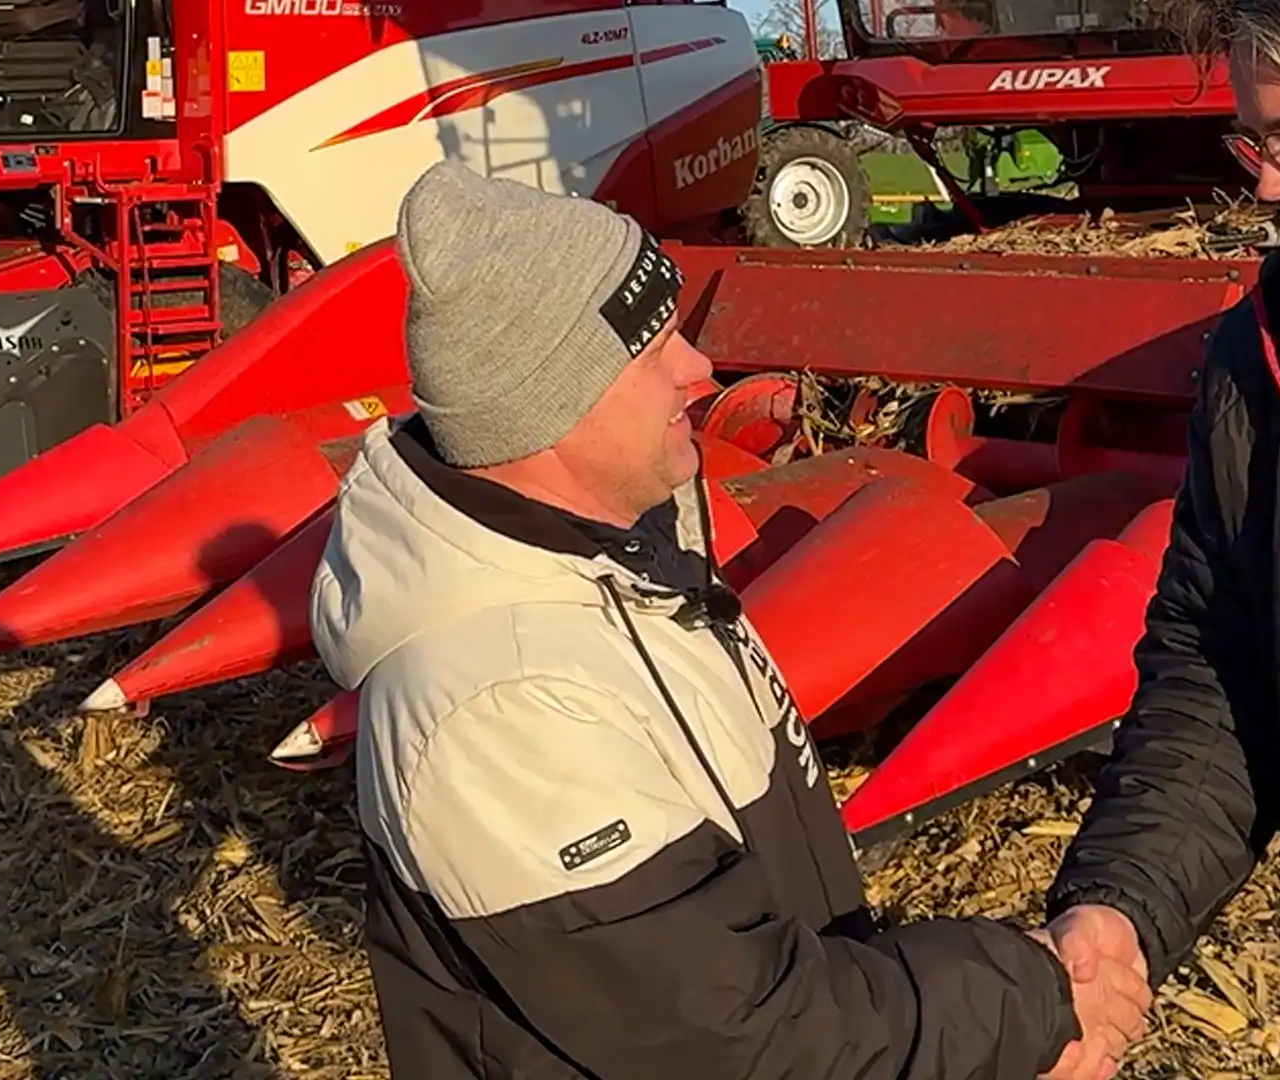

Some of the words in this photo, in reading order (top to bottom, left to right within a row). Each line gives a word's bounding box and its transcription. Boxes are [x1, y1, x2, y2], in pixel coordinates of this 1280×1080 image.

[988, 65, 1112, 92] AUPAX
[673, 127, 756, 190] Korban
[623, 250, 657, 305] JEZUS
